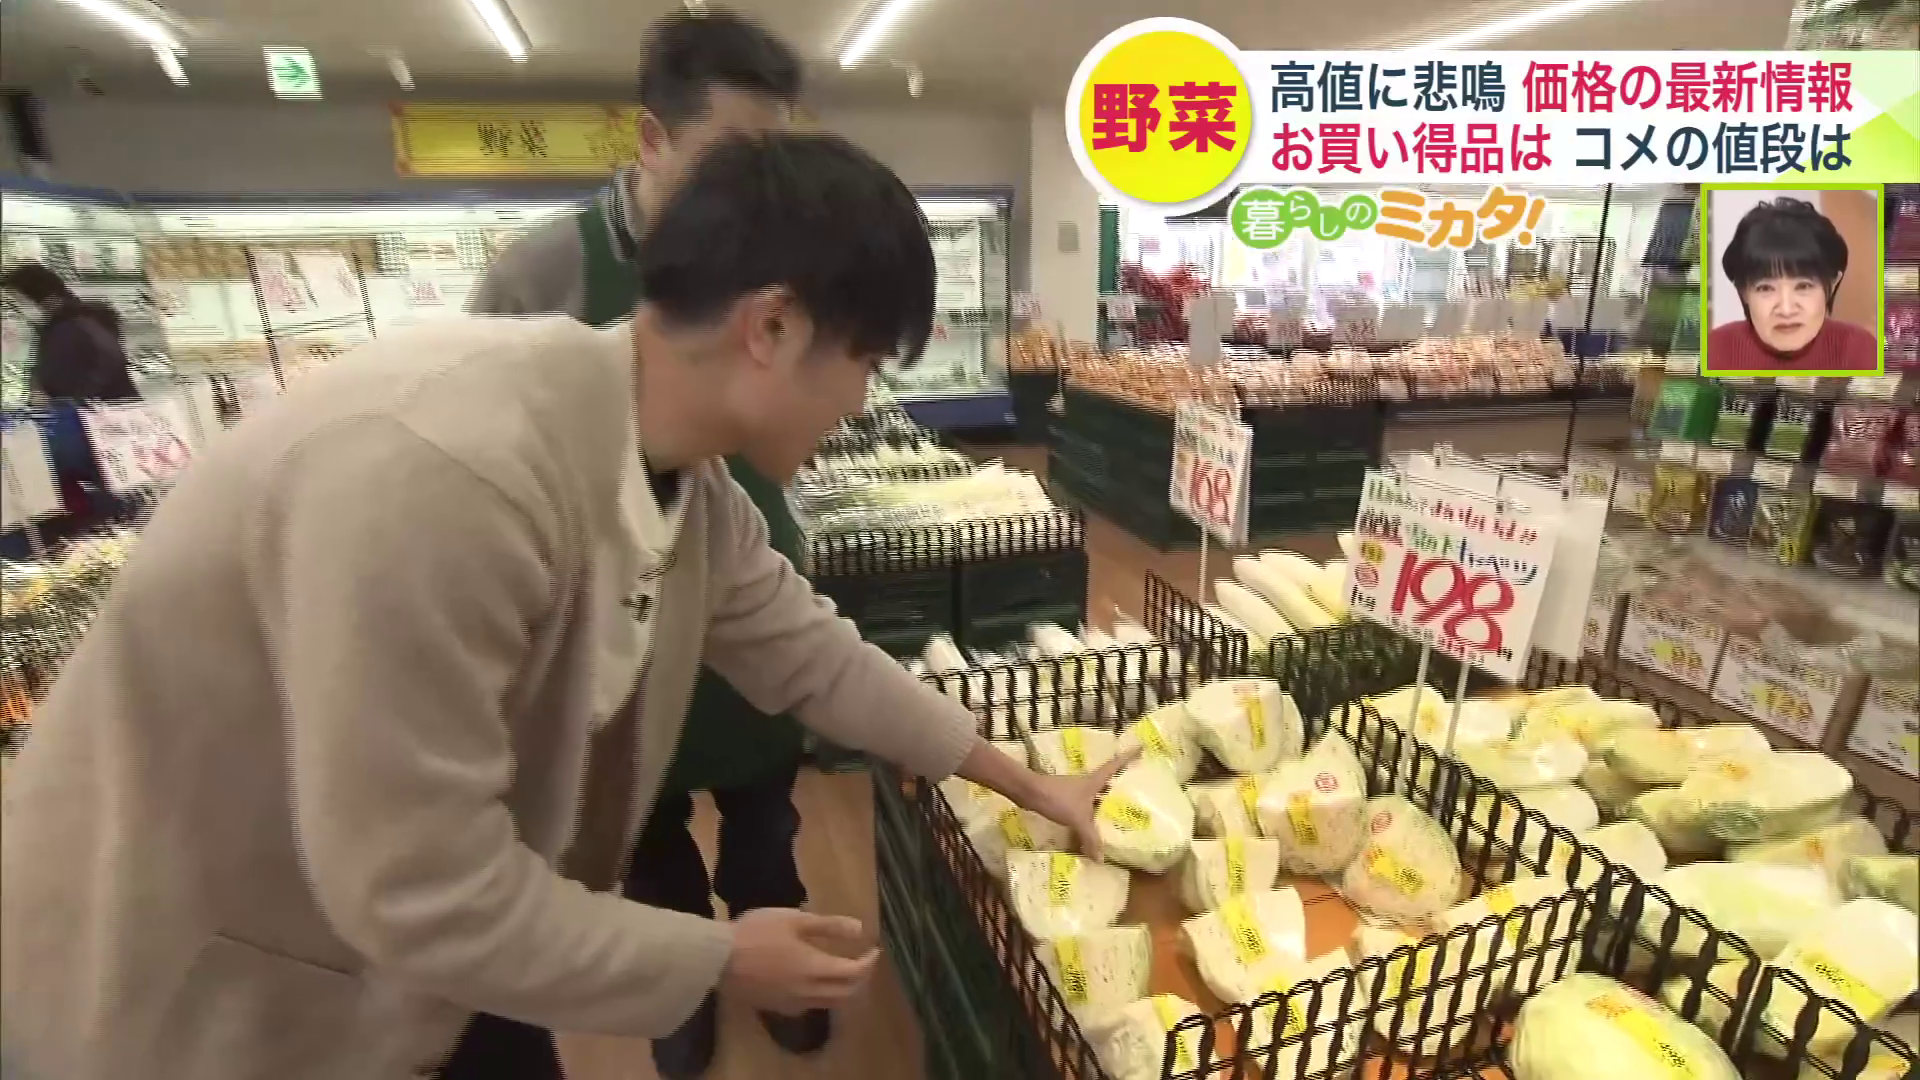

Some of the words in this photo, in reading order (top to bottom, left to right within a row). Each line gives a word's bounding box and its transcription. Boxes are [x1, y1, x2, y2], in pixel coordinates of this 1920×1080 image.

[478, 121, 548, 159] 野菜
[1189, 457, 1231, 526] 168
[1391, 549, 1514, 652] 198
